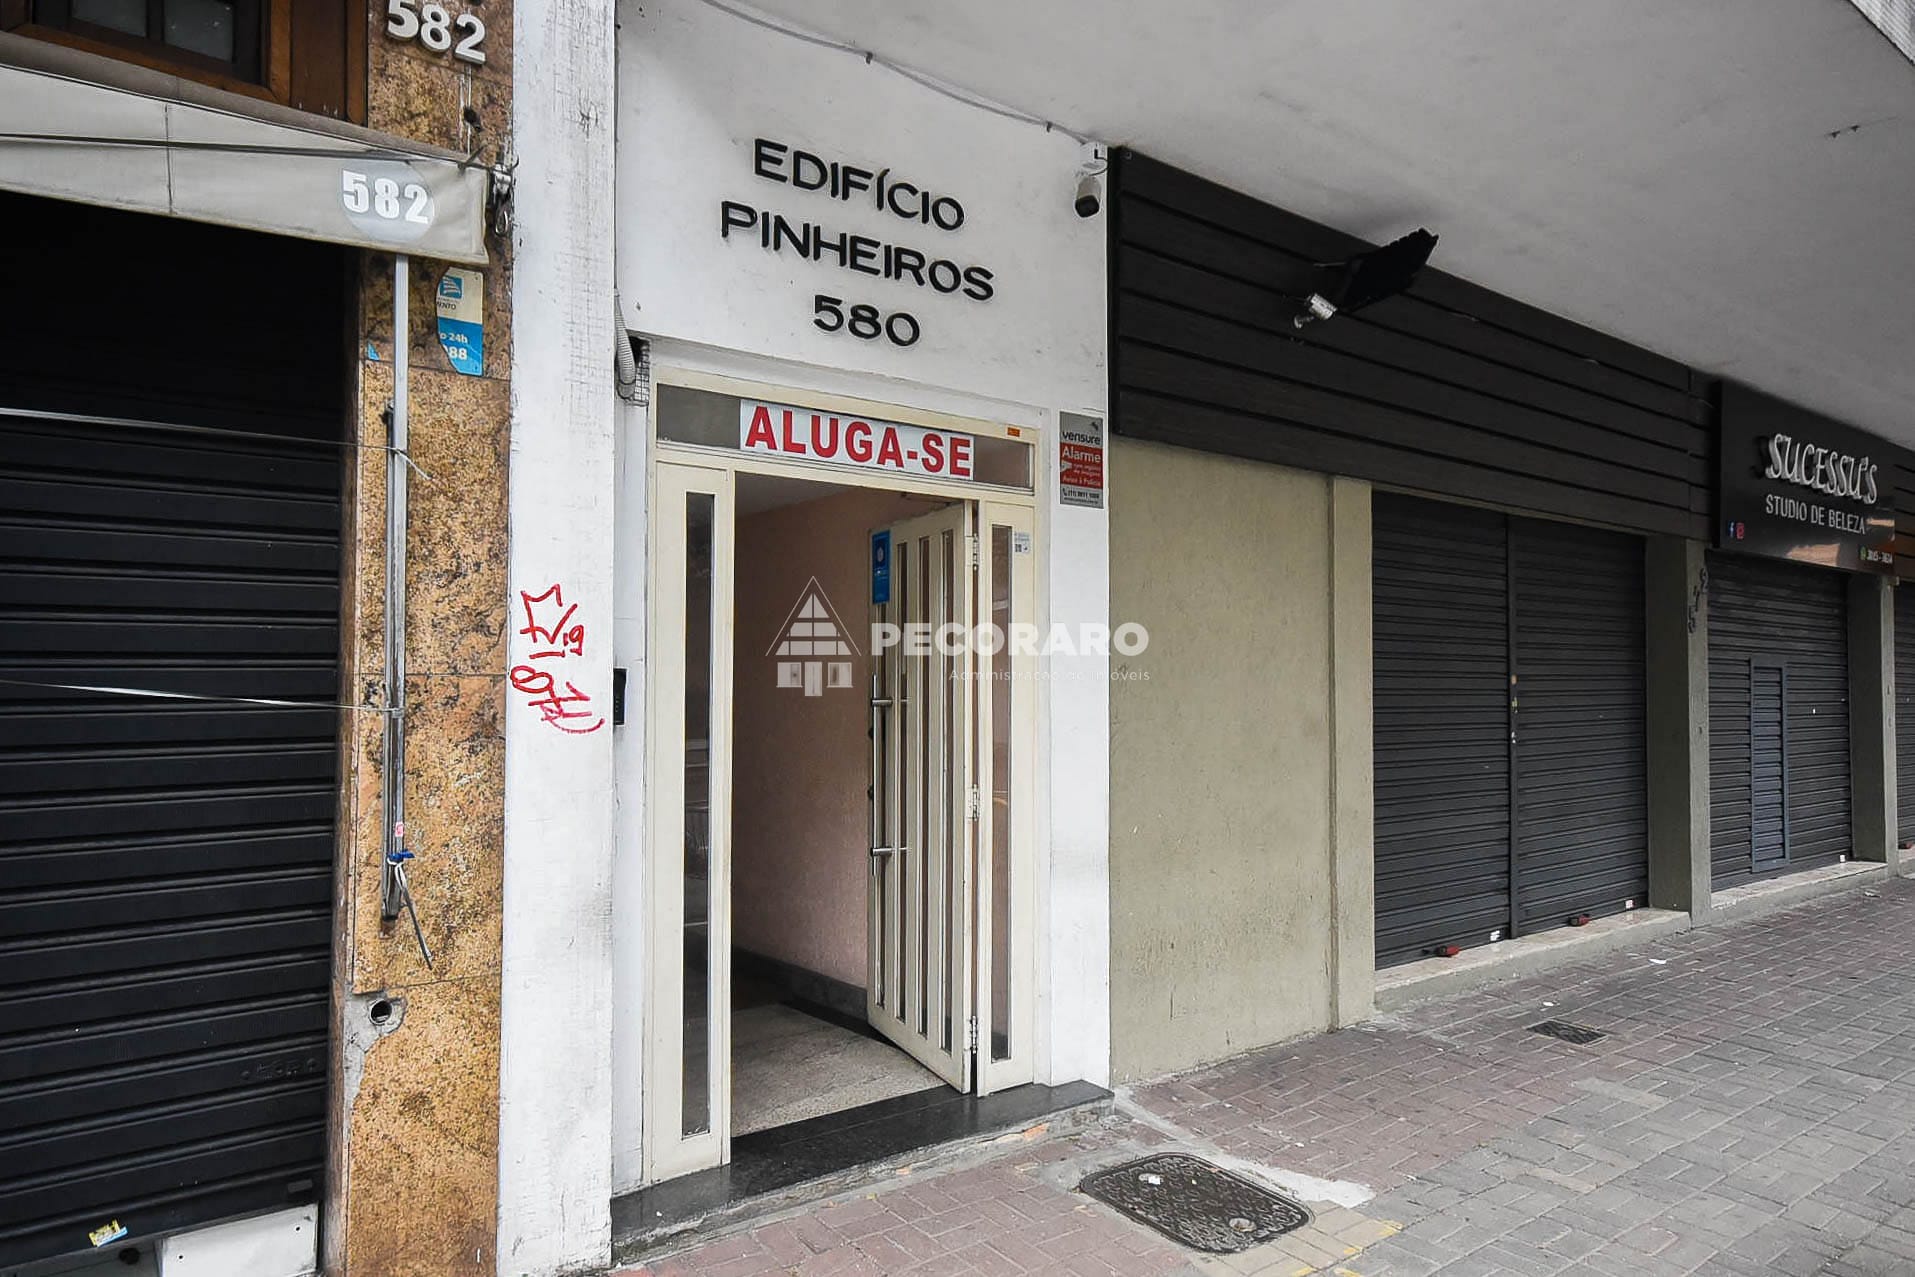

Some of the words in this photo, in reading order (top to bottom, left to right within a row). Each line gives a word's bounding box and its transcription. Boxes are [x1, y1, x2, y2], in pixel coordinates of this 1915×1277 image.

[386, 0, 486, 65] 582
[342, 168, 429, 224] 582
[754, 137, 965, 231] EDIFÍCIO
[721, 200, 994, 301] PINHEIROS
[449, 332, 468, 344] 24h
[813, 294, 920, 347] 580
[745, 405, 970, 477] ALUGA-SE
[1062, 446, 1101, 463] Alarme
[1766, 494, 1808, 521] STUDIO
[1811, 505, 1825, 526] DE
[1828, 509, 1866, 534] BELEZA
